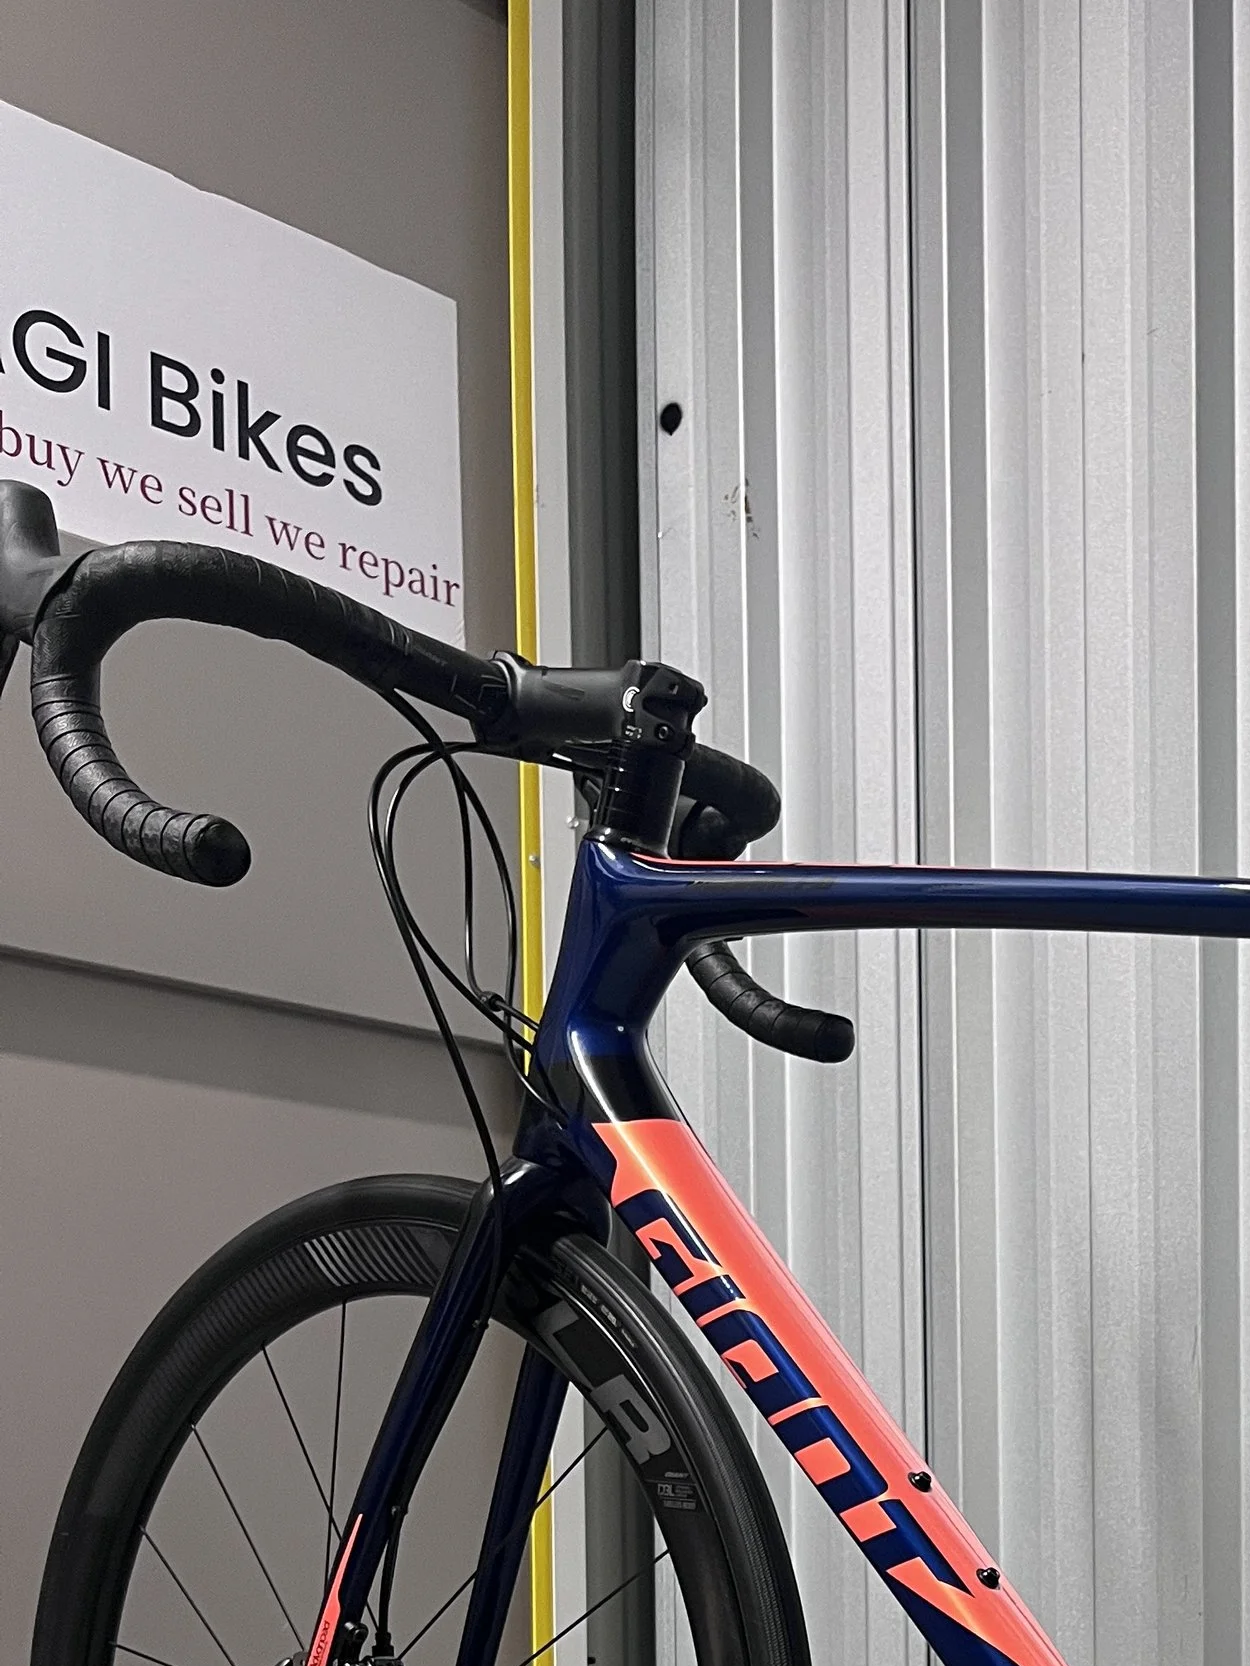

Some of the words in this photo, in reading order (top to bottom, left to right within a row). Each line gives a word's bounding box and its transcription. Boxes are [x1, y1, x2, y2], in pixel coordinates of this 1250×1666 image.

[0, 310, 111, 411] GI
[150, 351, 383, 507] Bikes
[97, 457, 164, 505] we
[178, 484, 254, 537] sell
[265, 515, 326, 560] we
[337, 542, 461, 607] repair
